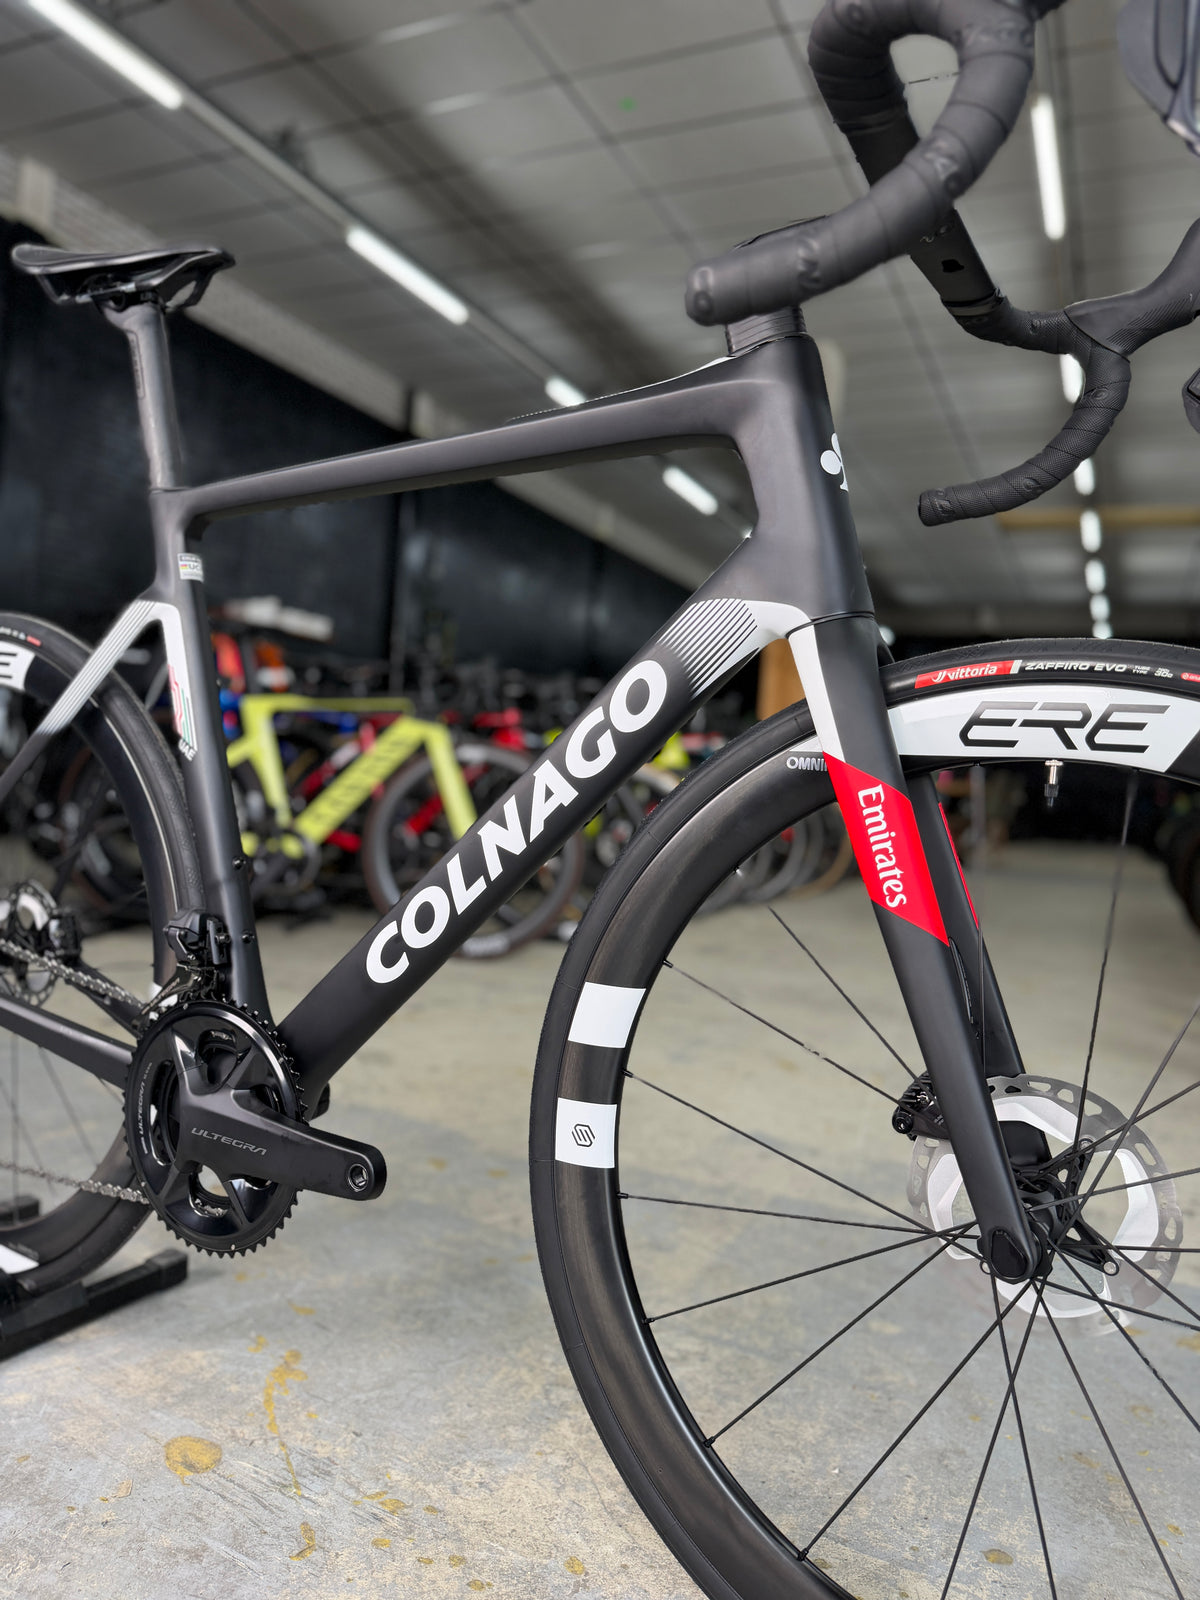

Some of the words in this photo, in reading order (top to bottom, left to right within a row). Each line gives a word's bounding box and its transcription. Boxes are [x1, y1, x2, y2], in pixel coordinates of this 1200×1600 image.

[1025, 661, 1090, 671] ZAFFIRO
[1094, 663, 1127, 672] EVO
[959, 700, 1171, 753] ERE
[366, 659, 668, 984] COLNAGO
[857, 784, 907, 908] Emirates
[191, 1127, 267, 1156] ULTEGRA
